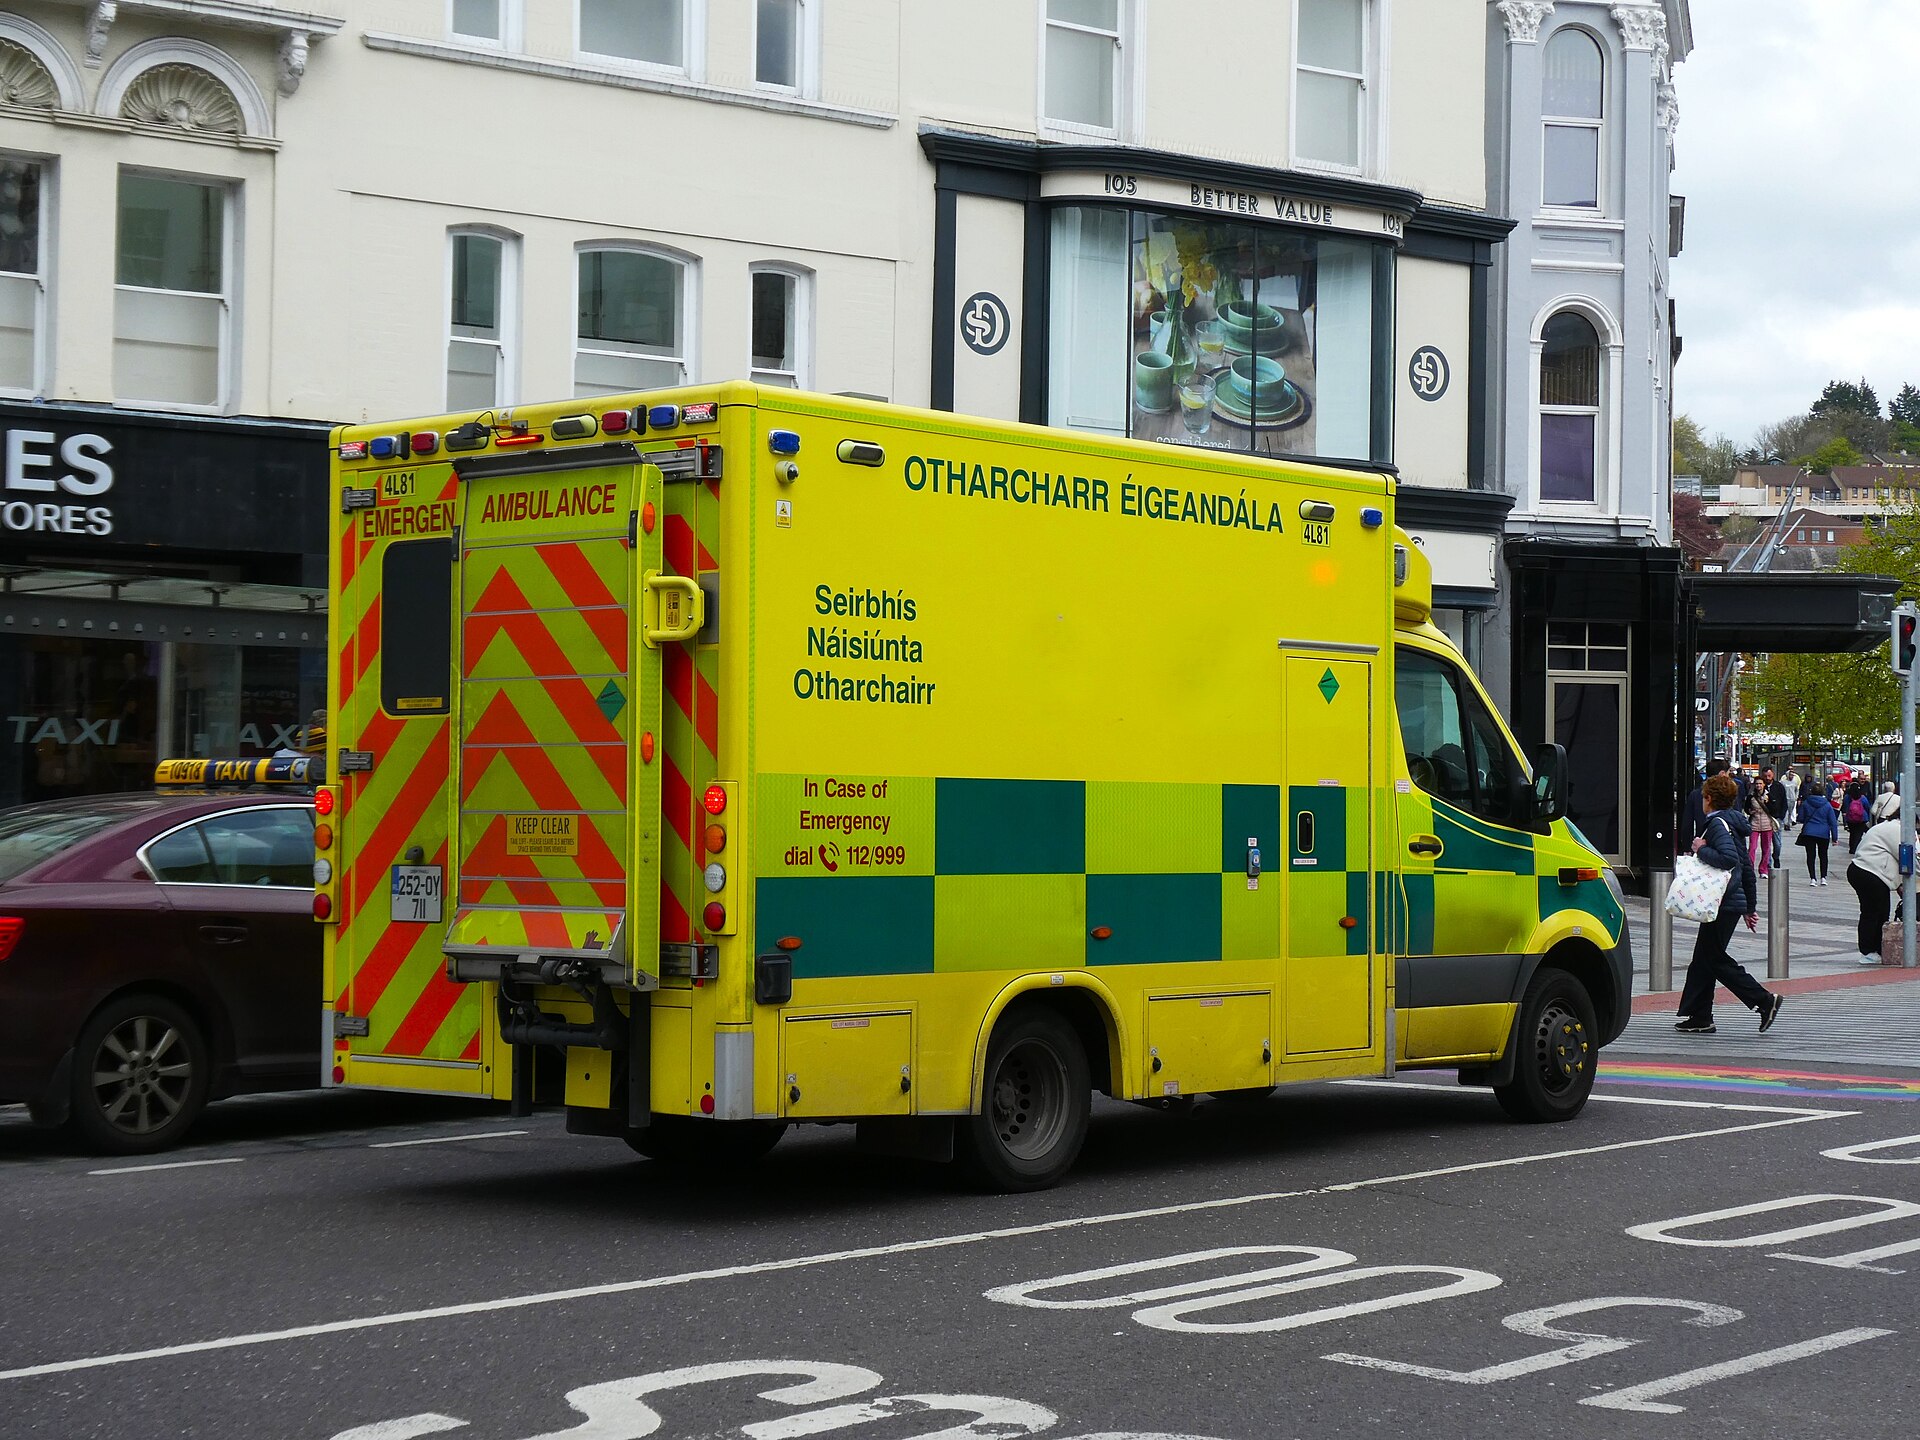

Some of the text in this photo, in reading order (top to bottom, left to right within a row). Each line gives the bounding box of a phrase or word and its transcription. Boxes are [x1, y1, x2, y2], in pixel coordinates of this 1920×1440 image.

[1103, 173, 1137, 195] 105
[1190, 183, 1333, 225] BETTER VALUE
[1382, 212, 1401, 235] 105
[5, 429, 114, 495] ES
[384, 471, 416, 497] 4L81
[903, 455, 1285, 534] OTHARCHARR ÉIGEANDÁLA
[481, 484, 617, 524] AMBULANCE
[1303, 523, 1330, 546] 4L81
[815, 584, 917, 621] Seirbhís
[807, 626, 923, 663] Náisiúnta
[793, 668, 936, 705] Otharchairr
[7, 715, 120, 746] TAXI
[214, 760, 252, 781] TAXI
[804, 778, 888, 798] In Case of
[515, 817, 570, 835] KEEP CLEAR
[800, 810, 891, 835] Emergency
[784, 845, 906, 867] dial 112/999
[412, 898, 426, 919] 711
